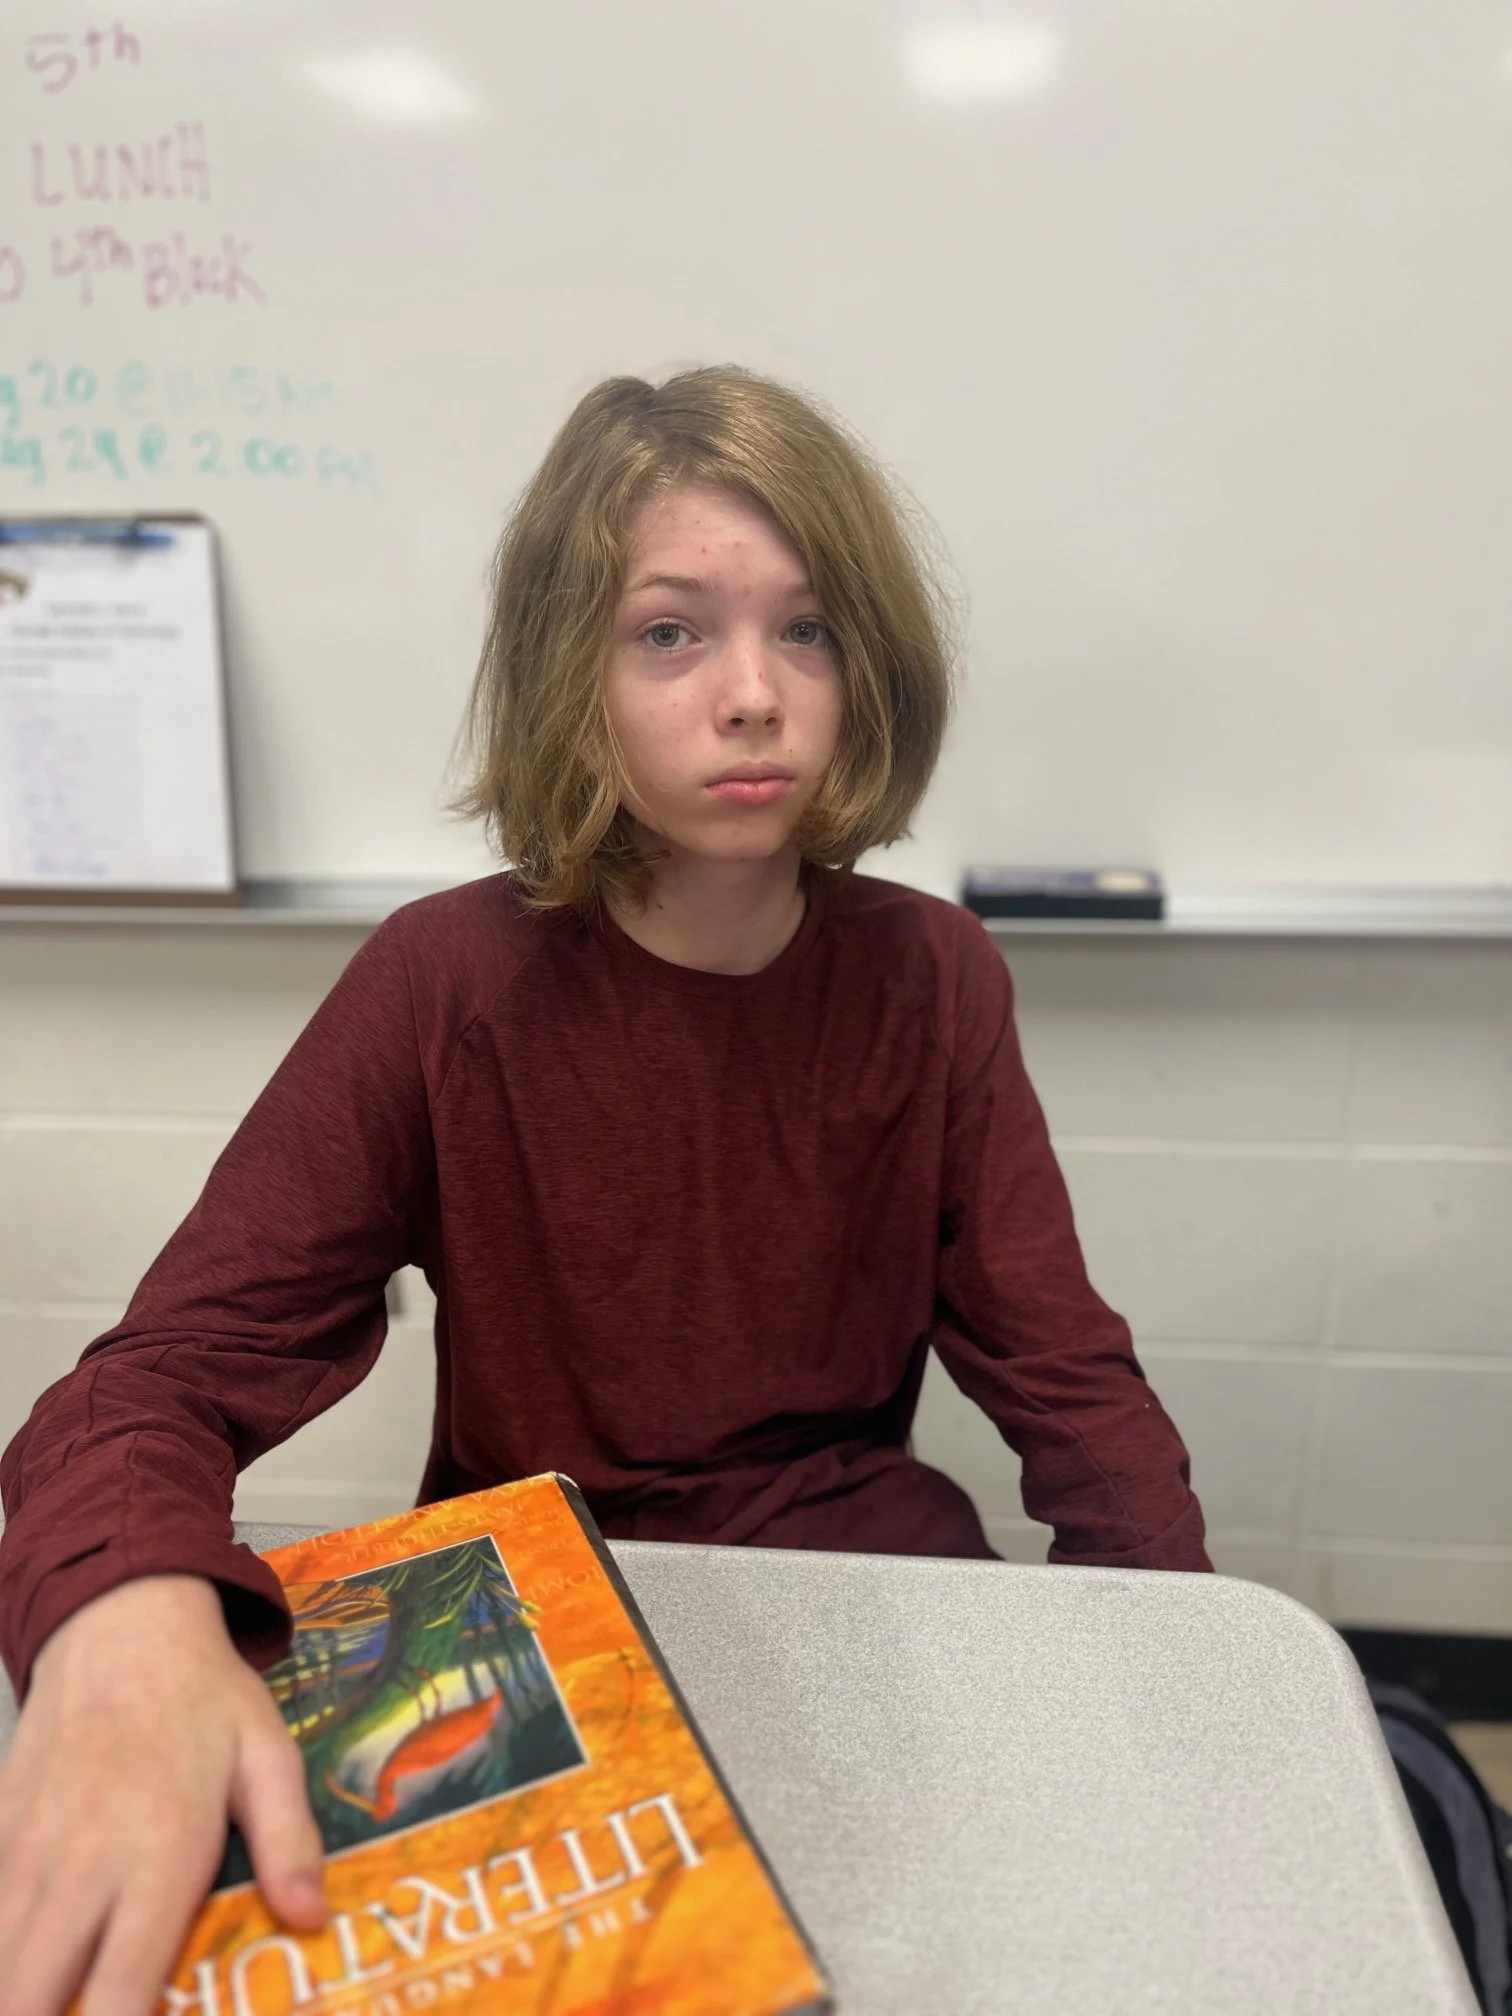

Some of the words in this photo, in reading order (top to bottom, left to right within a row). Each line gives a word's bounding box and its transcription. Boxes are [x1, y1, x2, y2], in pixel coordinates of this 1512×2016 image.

[26, 20, 142, 94] 5th
[31, 120, 211, 207] LUNCH
[166, 1792, 705, 2016] LITERATUR
[562, 1898, 653, 1950] THE
